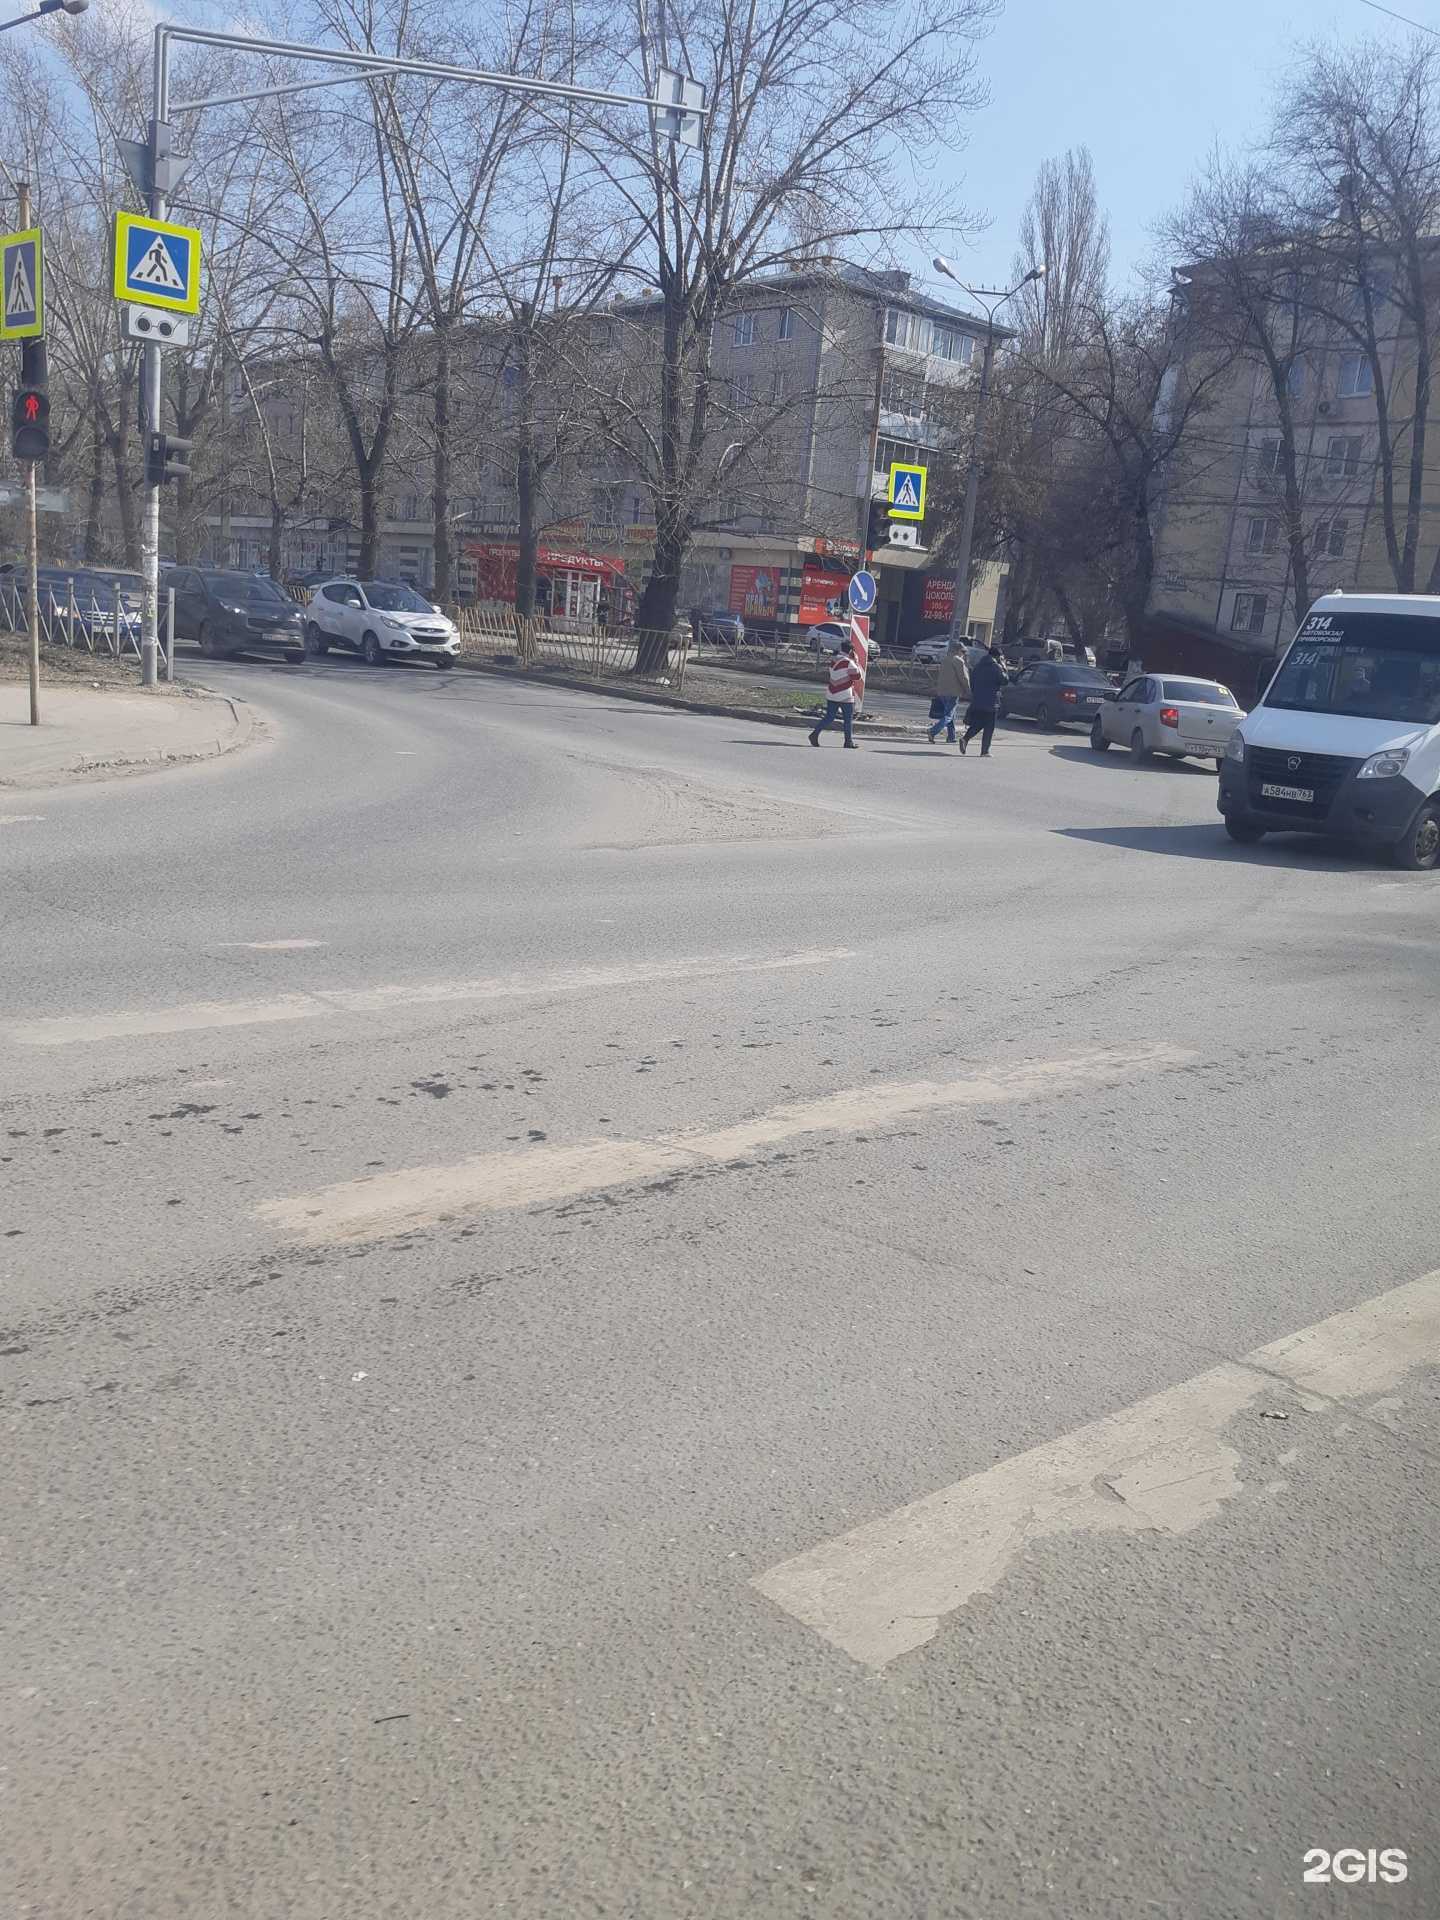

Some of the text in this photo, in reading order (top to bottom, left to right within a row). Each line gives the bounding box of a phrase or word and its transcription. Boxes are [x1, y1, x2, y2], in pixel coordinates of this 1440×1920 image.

[547, 551, 604, 567] ПРОДУКТЫ
[926, 580, 956, 591] АРЕНДА
[1306, 616, 1334, 630] 314
[1291, 652, 1317, 665] 314
